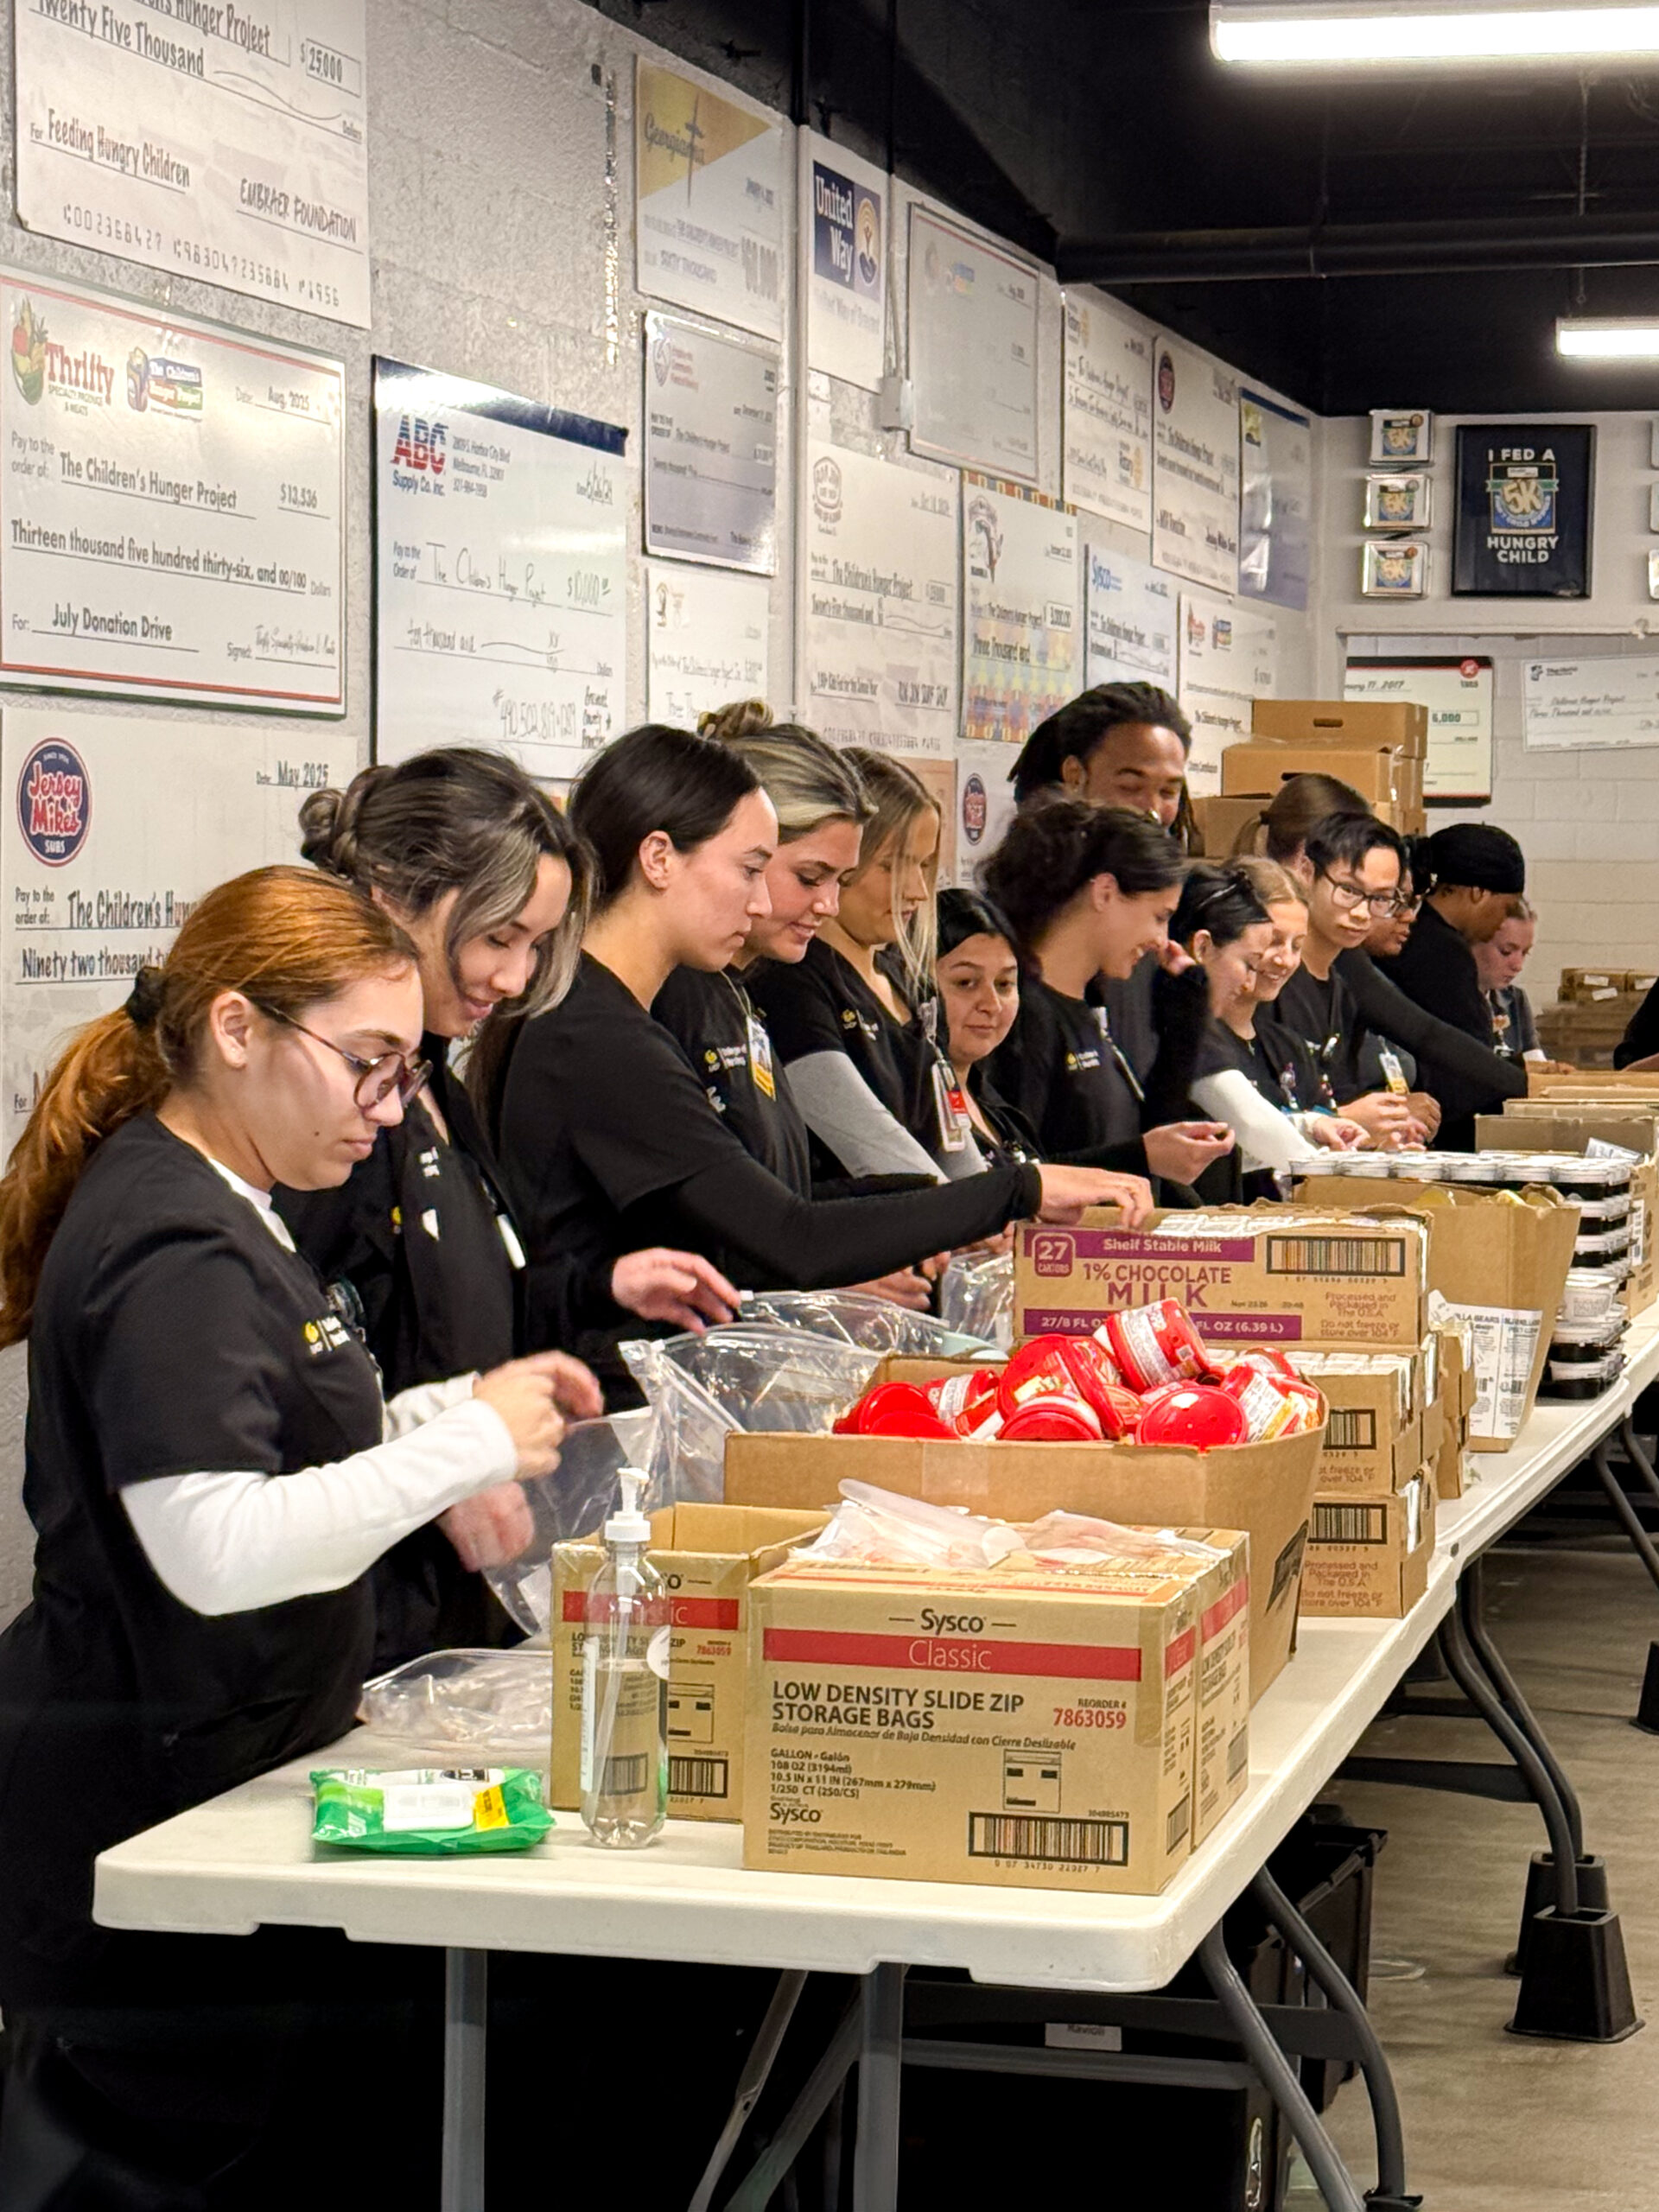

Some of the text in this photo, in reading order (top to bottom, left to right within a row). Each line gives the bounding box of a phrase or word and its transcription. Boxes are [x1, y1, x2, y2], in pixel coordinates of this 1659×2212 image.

[101, 4, 204, 77] Five Thousand
[226, 3, 270, 56] Project
[48, 108, 93, 162] Feeding
[97, 125, 139, 176] Hungry
[143, 142, 189, 188] Children
[816, 175, 853, 229] United
[294, 194, 357, 243] FOUNDATION
[830, 226, 854, 282] Way
[45, 342, 114, 405] Thrifty
[11, 430, 54, 455] Pay to the
[390, 415, 448, 474] ABC
[1488, 448, 1555, 461] I FED A
[11, 458, 35, 474] order
[60, 452, 82, 478] The
[86, 457, 145, 492] Children's
[149, 471, 193, 505] Hunger
[197, 480, 237, 512] Project
[392, 470, 418, 494] Supply
[1502, 479, 1542, 514] 5K
[11, 519, 66, 550] Thirteen
[70, 527, 124, 560] thousand
[129, 537, 149, 563] five
[152, 541, 200, 571] hundred
[257, 563, 276, 583] and
[1486, 536, 1560, 550] HUNGRY
[1497, 550, 1549, 563] CHILD
[53, 603, 78, 634] July
[83, 605, 137, 638] Donation
[142, 615, 172, 641] Drive
[1381, 679, 1405, 690] 2017
[277, 760, 328, 787] May 2025
[29, 762, 82, 809] Jersey
[31, 798, 81, 836] Mike's
[45, 840, 66, 854] SUBS
[16, 886, 54, 906] Pay to the
[16, 908, 36, 925] order
[67, 889, 161, 929] The Children's
[22, 945, 152, 981] Ninety two thousand
[1039, 1241, 1068, 1261] 27
[1103, 1238, 1222, 1253] Shelf Stable Milk
[1083, 1263, 1231, 1284] 1% CHOCOLATE
[1325, 1292, 1396, 1301] Processed and
[1041, 1317, 1088, 1328] 27/8 FL
[1214, 1321, 1233, 1332] OZ
[1236, 1320, 1268, 1332] (6.39
[1321, 1319, 1335, 1328] Do
[1345, 1474, 1363, 1483] 104
[1305, 1560, 1378, 1571] Processed and
[1318, 1578, 1335, 1586] The
[1317, 1590, 1382, 1601] not freeze or
[1328, 1599, 1370, 1608] over 104
[920, 1608, 985, 1636] Sysco
[671, 1638, 686, 1648] ZIP
[909, 1640, 993, 1671] Classic
[772, 1681, 1024, 1713] LOW DENSITY SLIDE ZIP
[1077, 1698, 1120, 1710] REORDER
[772, 1701, 935, 1730] STORAGE BAGS
[1052, 1707, 1127, 1730] 7863059
[772, 1722, 1076, 1751] Bolsa para Almacenar de Baja Densidad con Cierre Deslizable
[771, 1748, 850, 1763] GALLON Galón
[771, 1760, 852, 1774] 108 OZ (3194ml)
[771, 1772, 791, 1783] 10.5
[794, 1773, 804, 1783] IN
[816, 1775, 827, 1784] 11
[830, 1776, 841, 1785] IN
[842, 1776, 884, 1789] (267mm
[893, 1779, 937, 1792] 279mm)
[771, 1783, 860, 1800] 1/250 CT (250/CS)
[770, 1802, 823, 1826] Sysco
